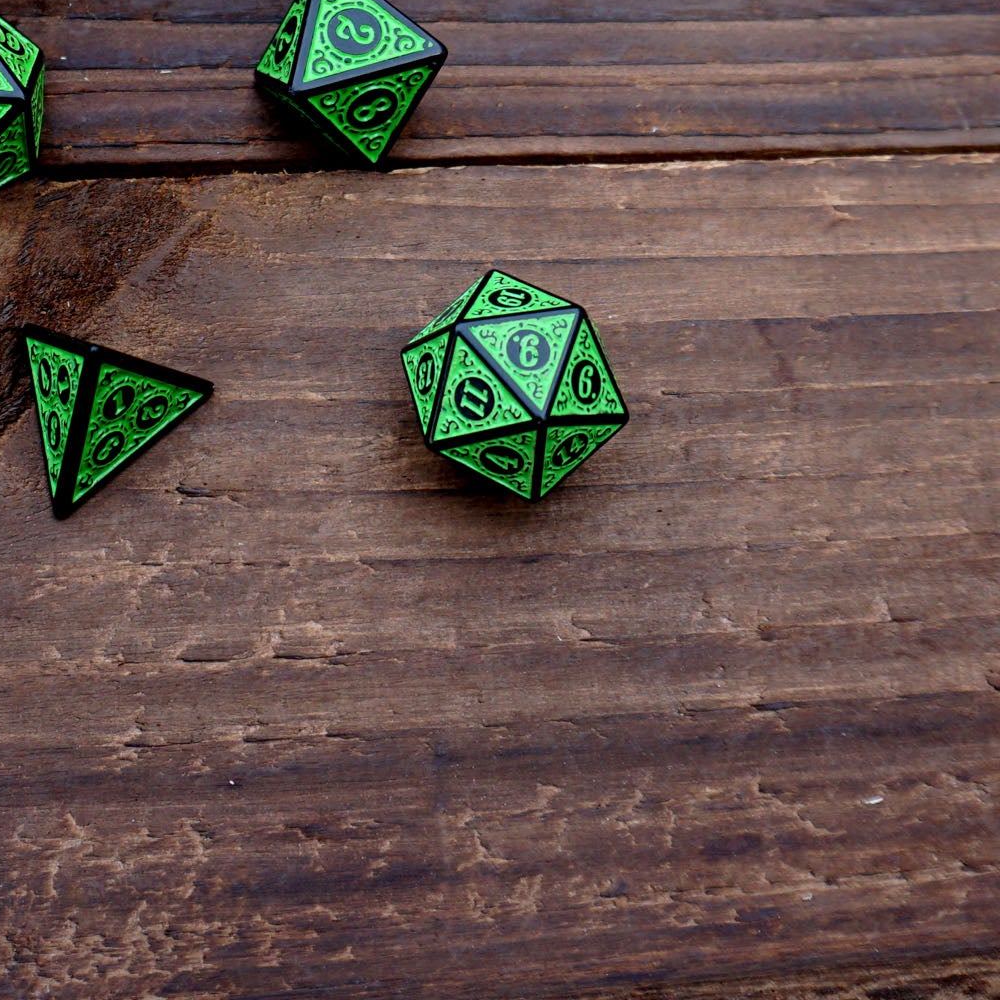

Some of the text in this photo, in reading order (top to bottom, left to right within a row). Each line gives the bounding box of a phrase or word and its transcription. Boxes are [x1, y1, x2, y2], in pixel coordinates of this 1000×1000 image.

[335, 14, 375, 46] 2
[353, 93, 391, 121] 8
[113, 389, 125, 415] 1
[142, 403, 166, 421] 2
[461, 381, 489, 417] 11
[99, 438, 119, 458] 3
[485, 452, 520, 471] 4
[557, 435, 586, 463] 14
